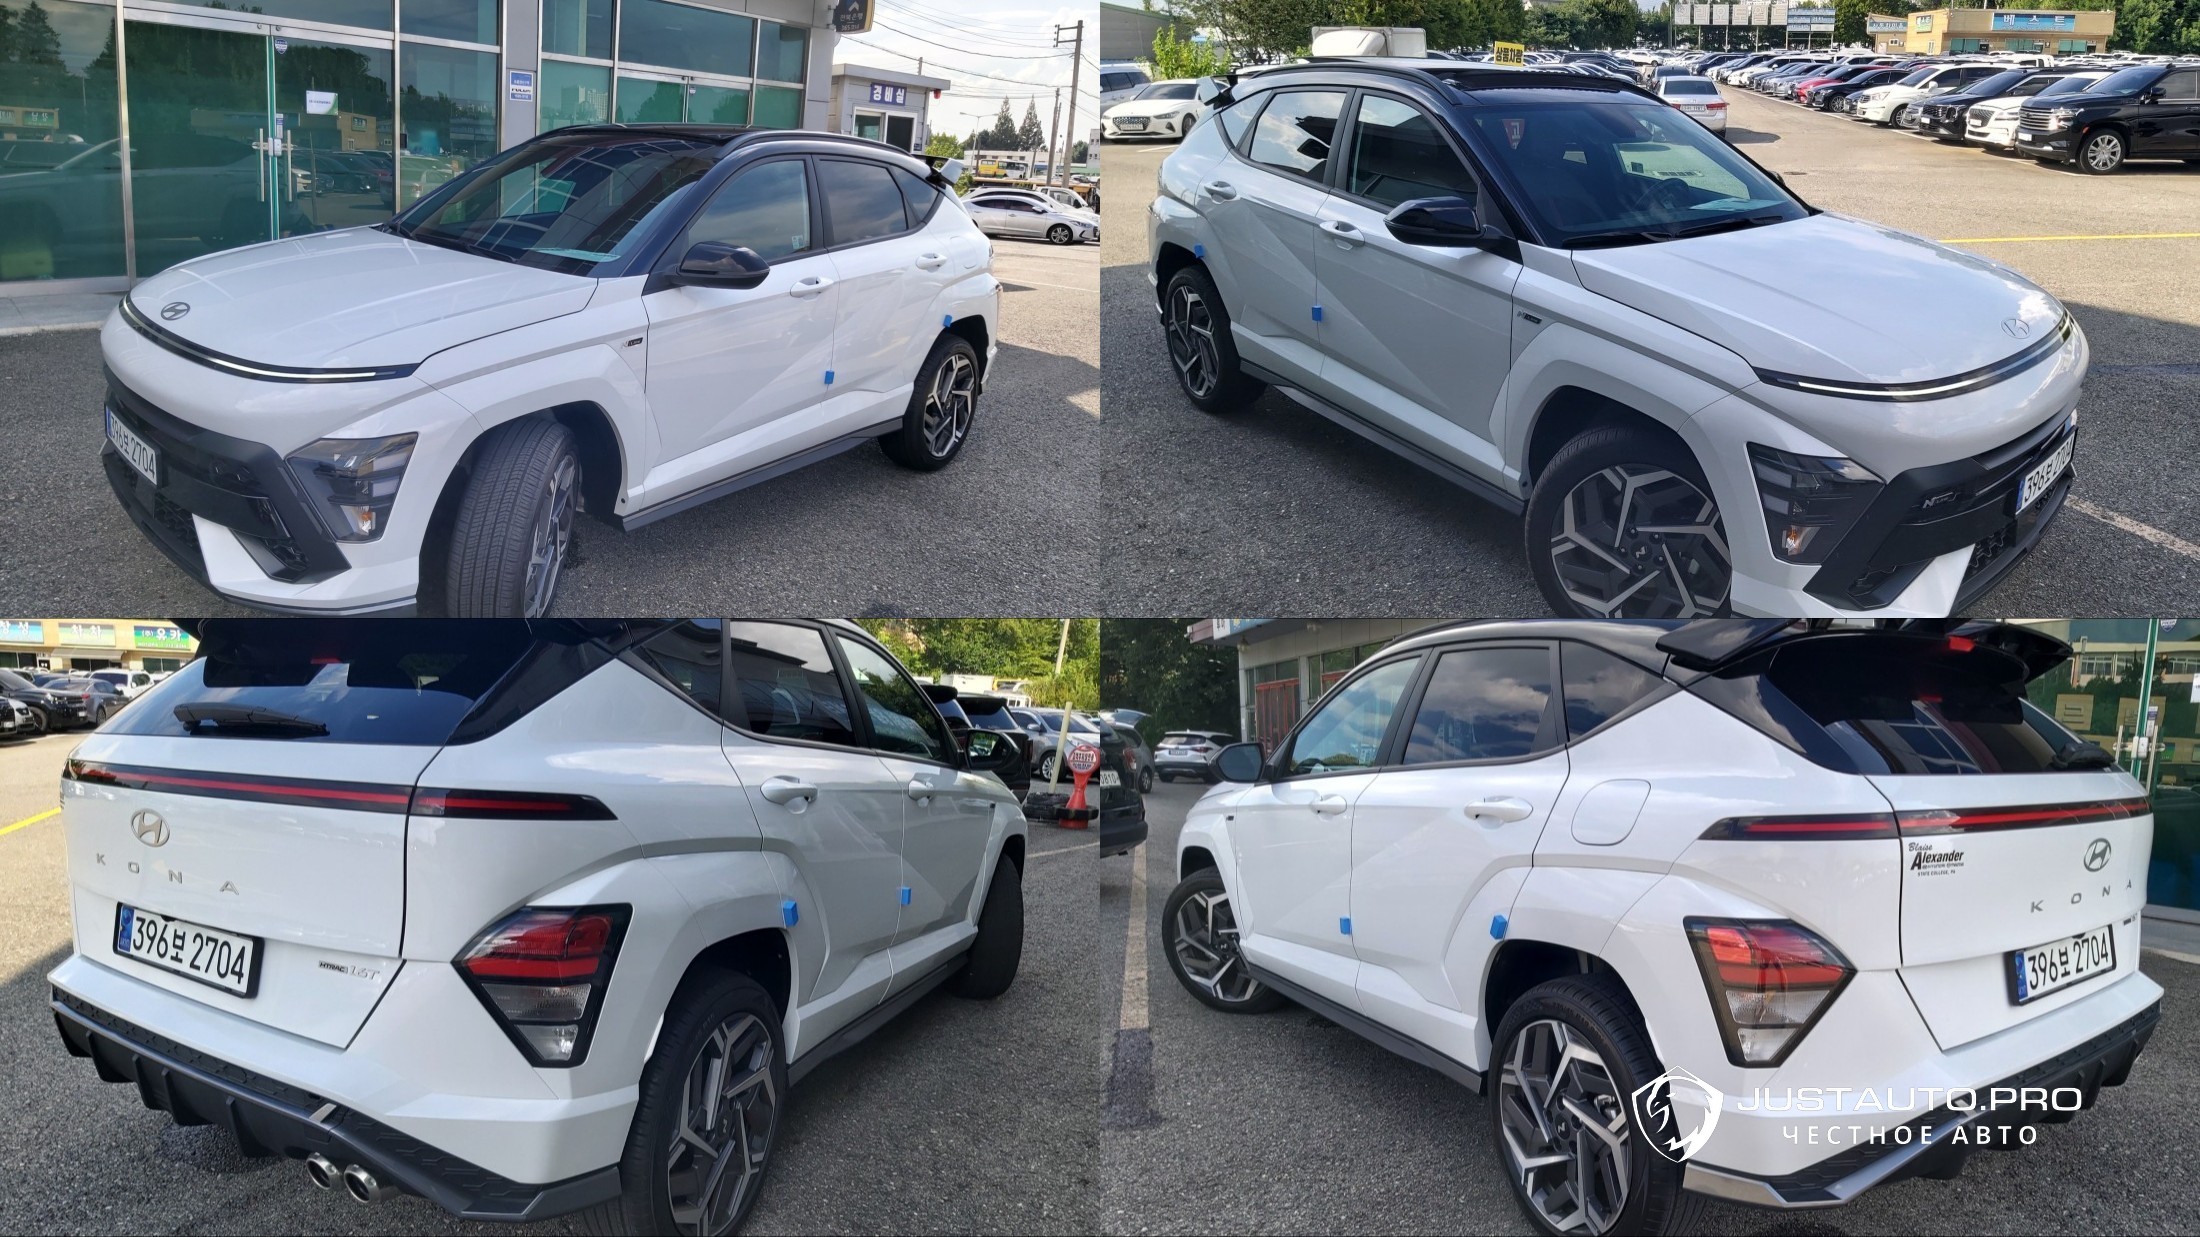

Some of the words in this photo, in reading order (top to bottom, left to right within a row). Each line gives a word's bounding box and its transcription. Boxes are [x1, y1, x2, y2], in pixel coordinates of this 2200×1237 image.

[2003, 14, 2066, 27] 베스트
[1496, 46, 1523, 63] 상품차량
[873, 85, 905, 104] 경비실
[131, 437, 155, 479] 2704
[1908, 842, 1933, 852] Blaise
[1910, 850, 1964, 870] Alexander
[96, 853, 239, 895] KONA
[2030, 879, 2133, 913] KONA
[132, 916, 186, 964] 396보
[189, 932, 247, 984] 2704
[2027, 947, 2071, 990] 396보
[2073, 932, 2109, 974] 2704
